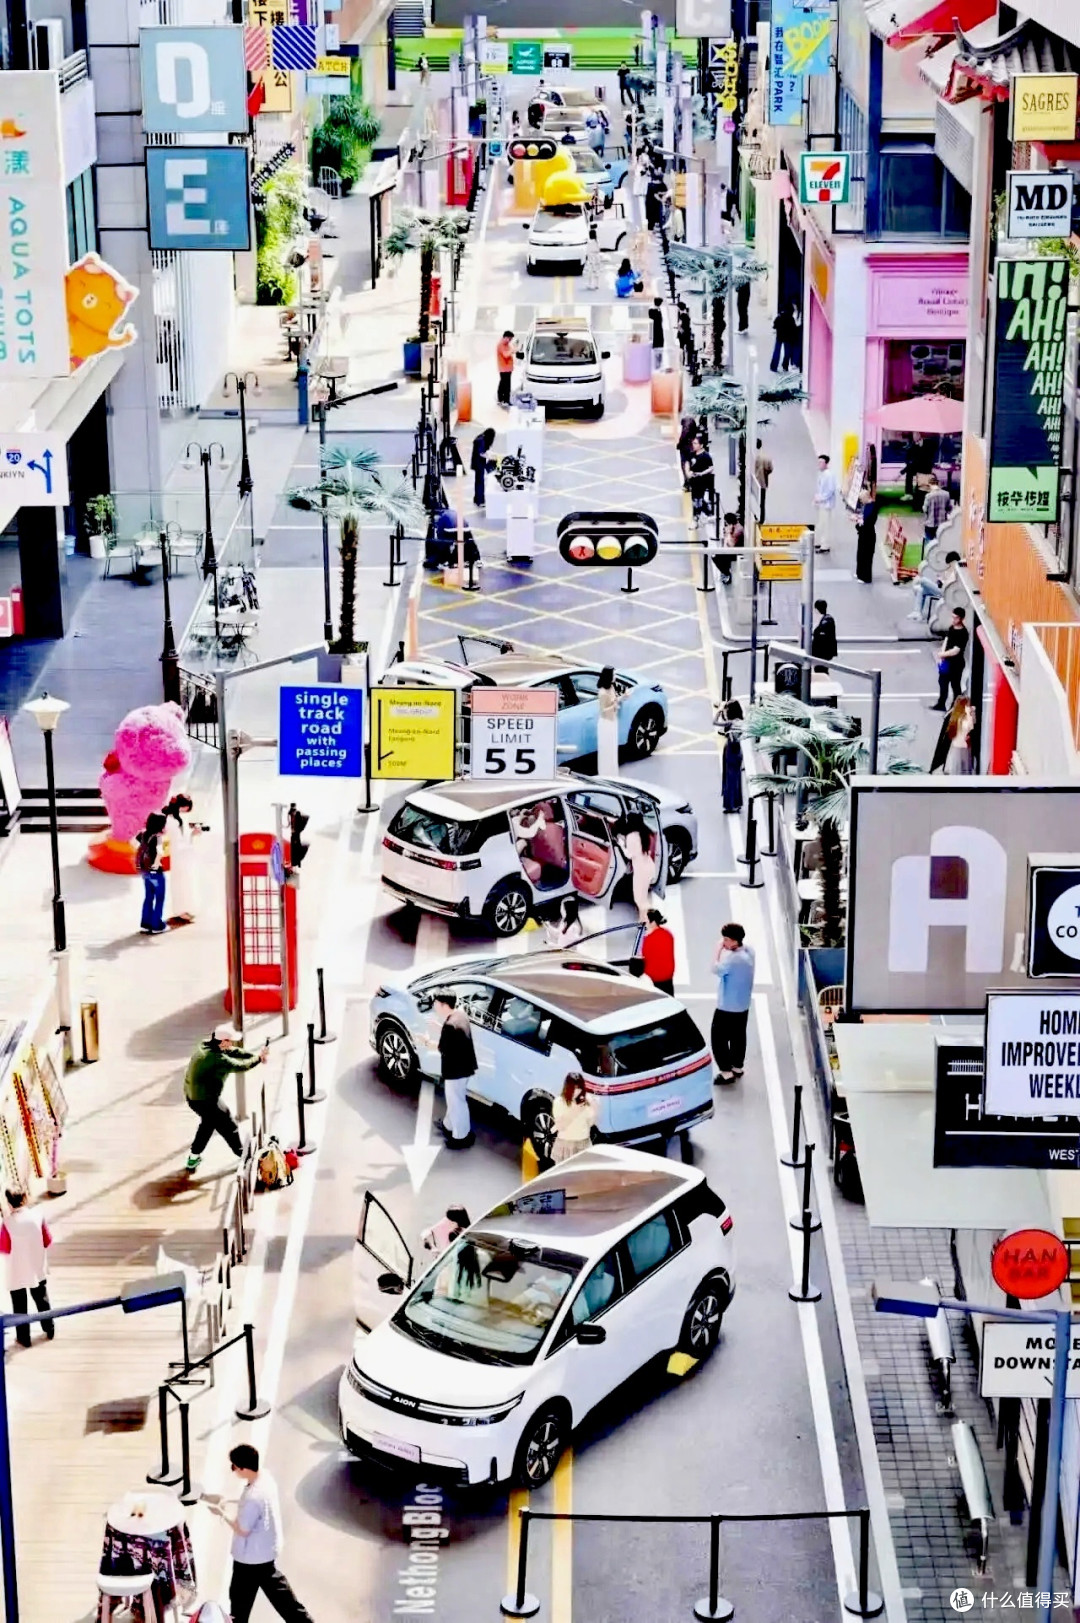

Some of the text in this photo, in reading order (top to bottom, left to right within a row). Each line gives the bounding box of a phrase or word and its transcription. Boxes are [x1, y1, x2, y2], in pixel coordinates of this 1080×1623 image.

[155, 42, 210, 118] D
[1022, 92, 1070, 111] SAGRES
[165, 159, 211, 235] E
[1014, 184, 1068, 210] MD
[8, 196, 36, 363] AQUA TOTS
[1005, 297, 1067, 341] AH!
[1023, 341, 1064, 371] AH!
[1030, 371, 1063, 396] AH!
[1037, 396, 1062, 415] AH!
[1043, 416, 1061, 430] AH!
[9, 453, 20, 462] 20
[295, 691, 349, 709] single
[299, 706, 345, 720] track
[301, 721, 343, 735] road
[487, 718, 534, 730] SPEED
[306, 736, 337, 746] with
[491, 733, 532, 744] LIMIT
[296, 746, 347, 760] passing
[485, 748, 536, 775] 55
[300, 757, 343, 769] places
[888, 825, 1008, 973] A
[1055, 925, 1078, 938] CO
[1040, 1010, 1080, 1036] HOM
[1003, 1248, 1058, 1264] HAN
[1026, 1337, 1080, 1350] MOE
[393, 1396, 416, 1408] AION
